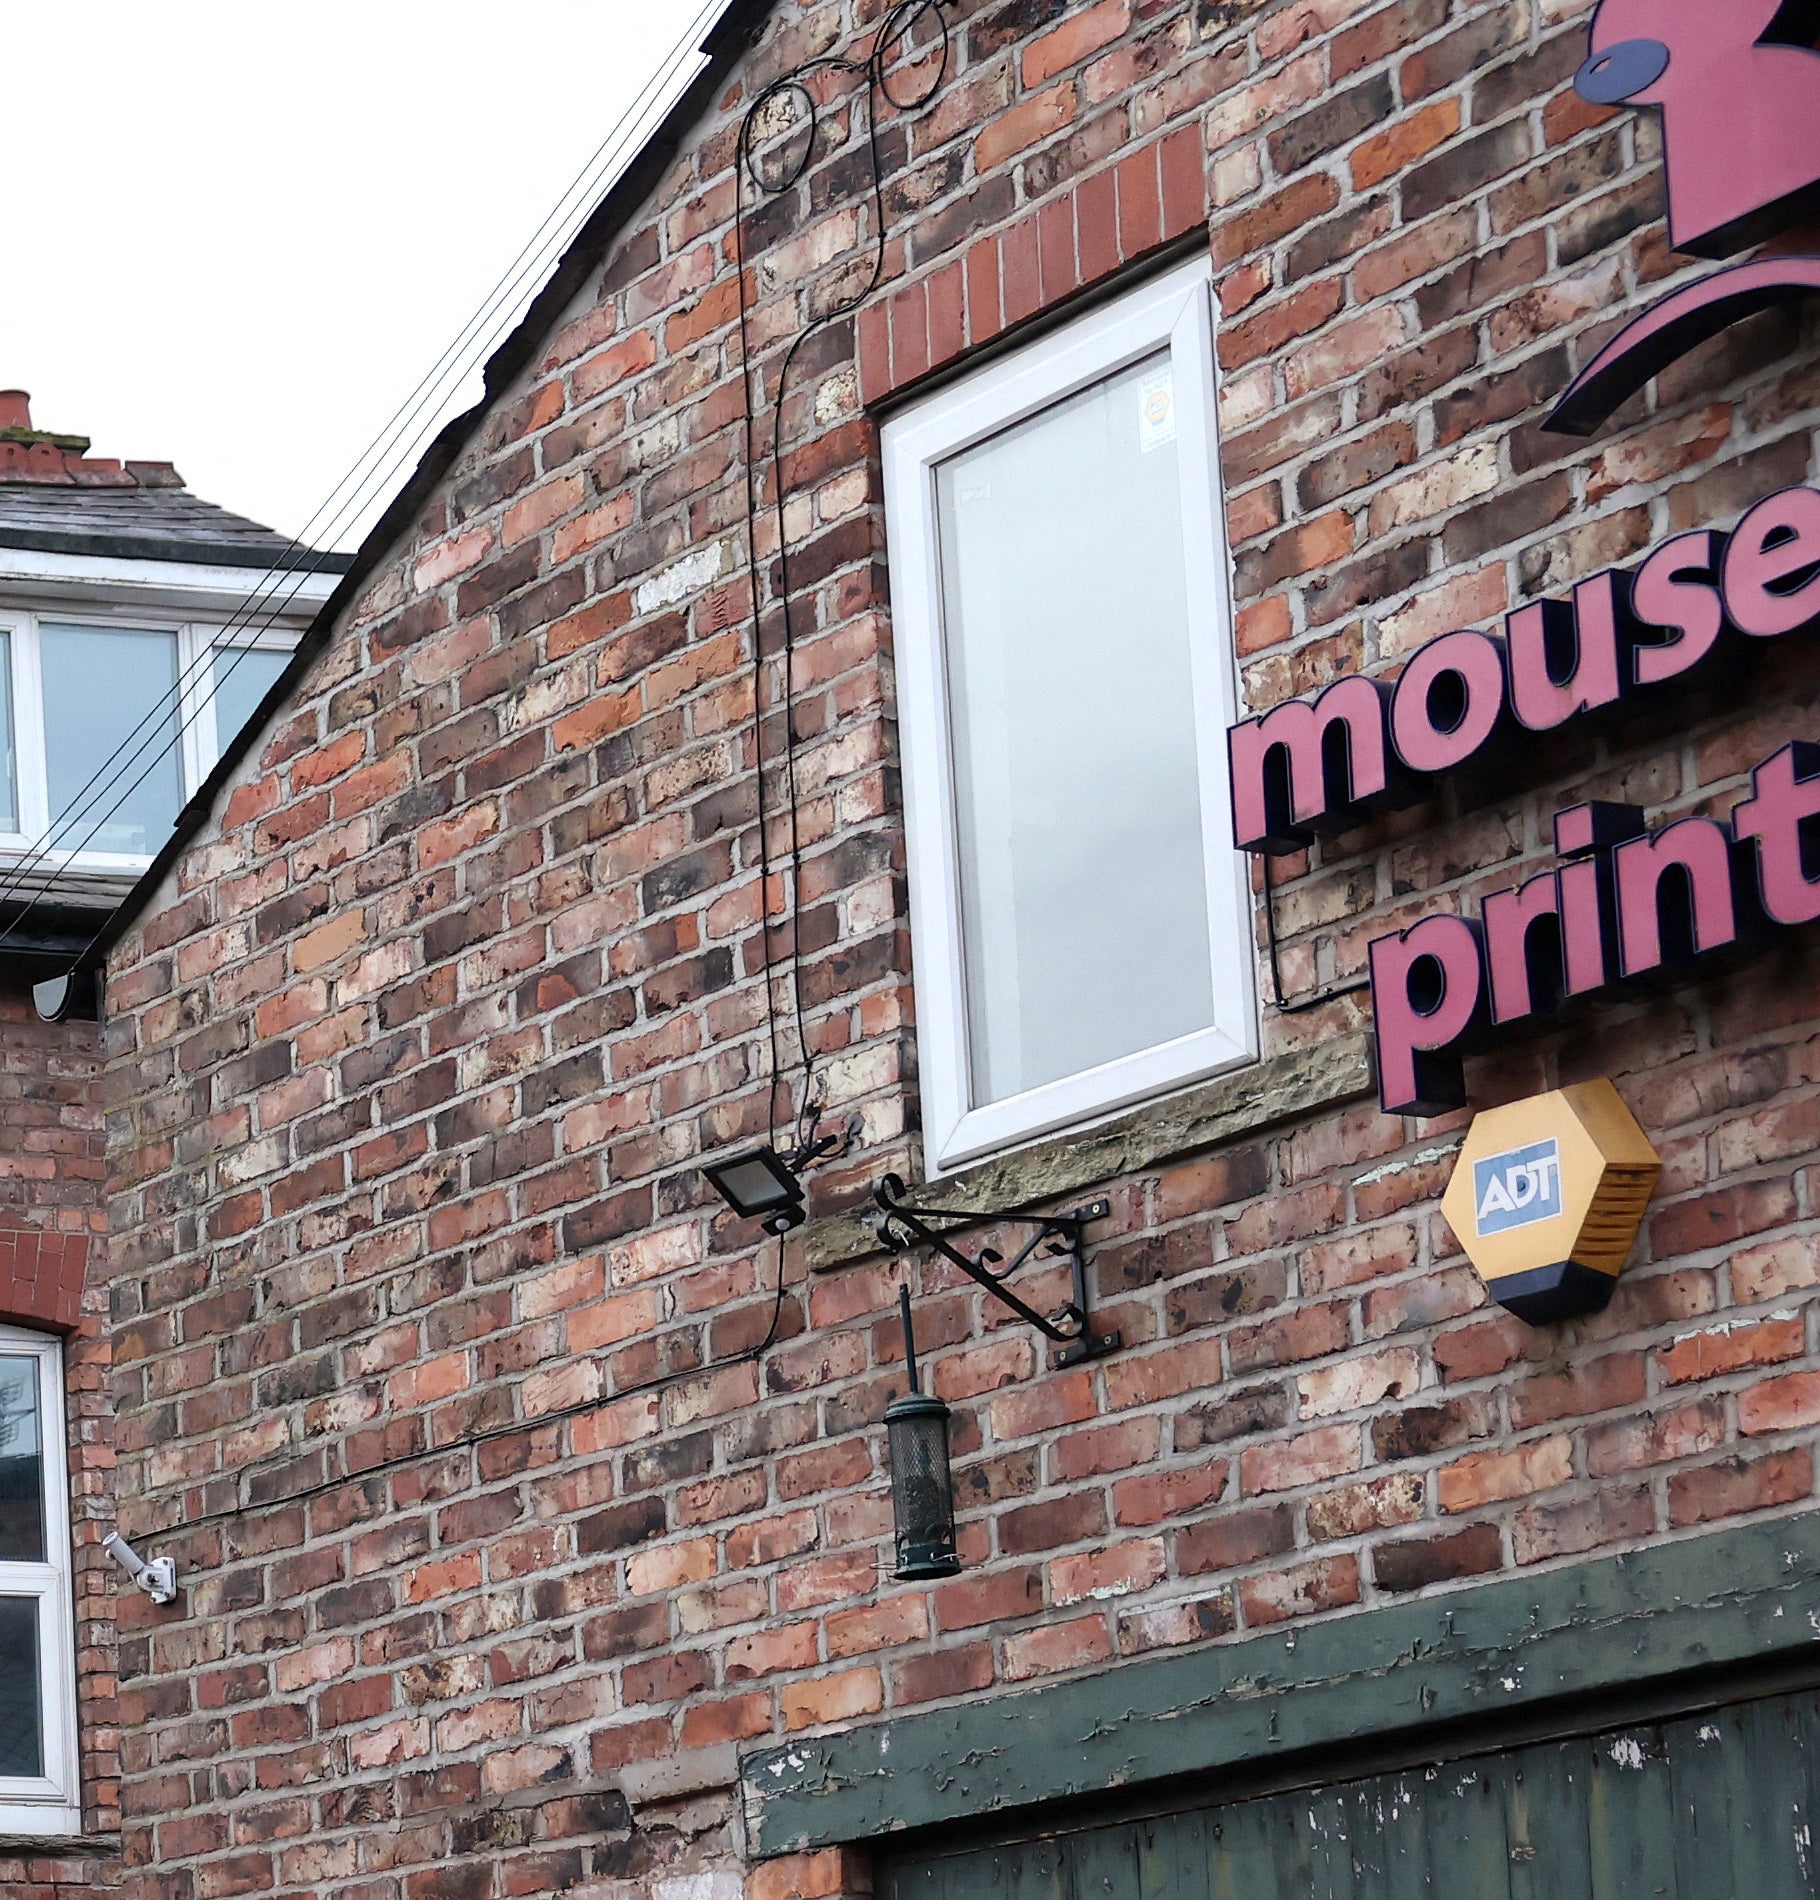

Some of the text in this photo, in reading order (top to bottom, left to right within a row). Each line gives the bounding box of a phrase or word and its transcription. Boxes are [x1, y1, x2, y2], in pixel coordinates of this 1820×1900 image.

[1226, 485, 1820, 852] mouse
[1368, 741, 1820, 1114] print
[1476, 1154, 1558, 1219] ADT
